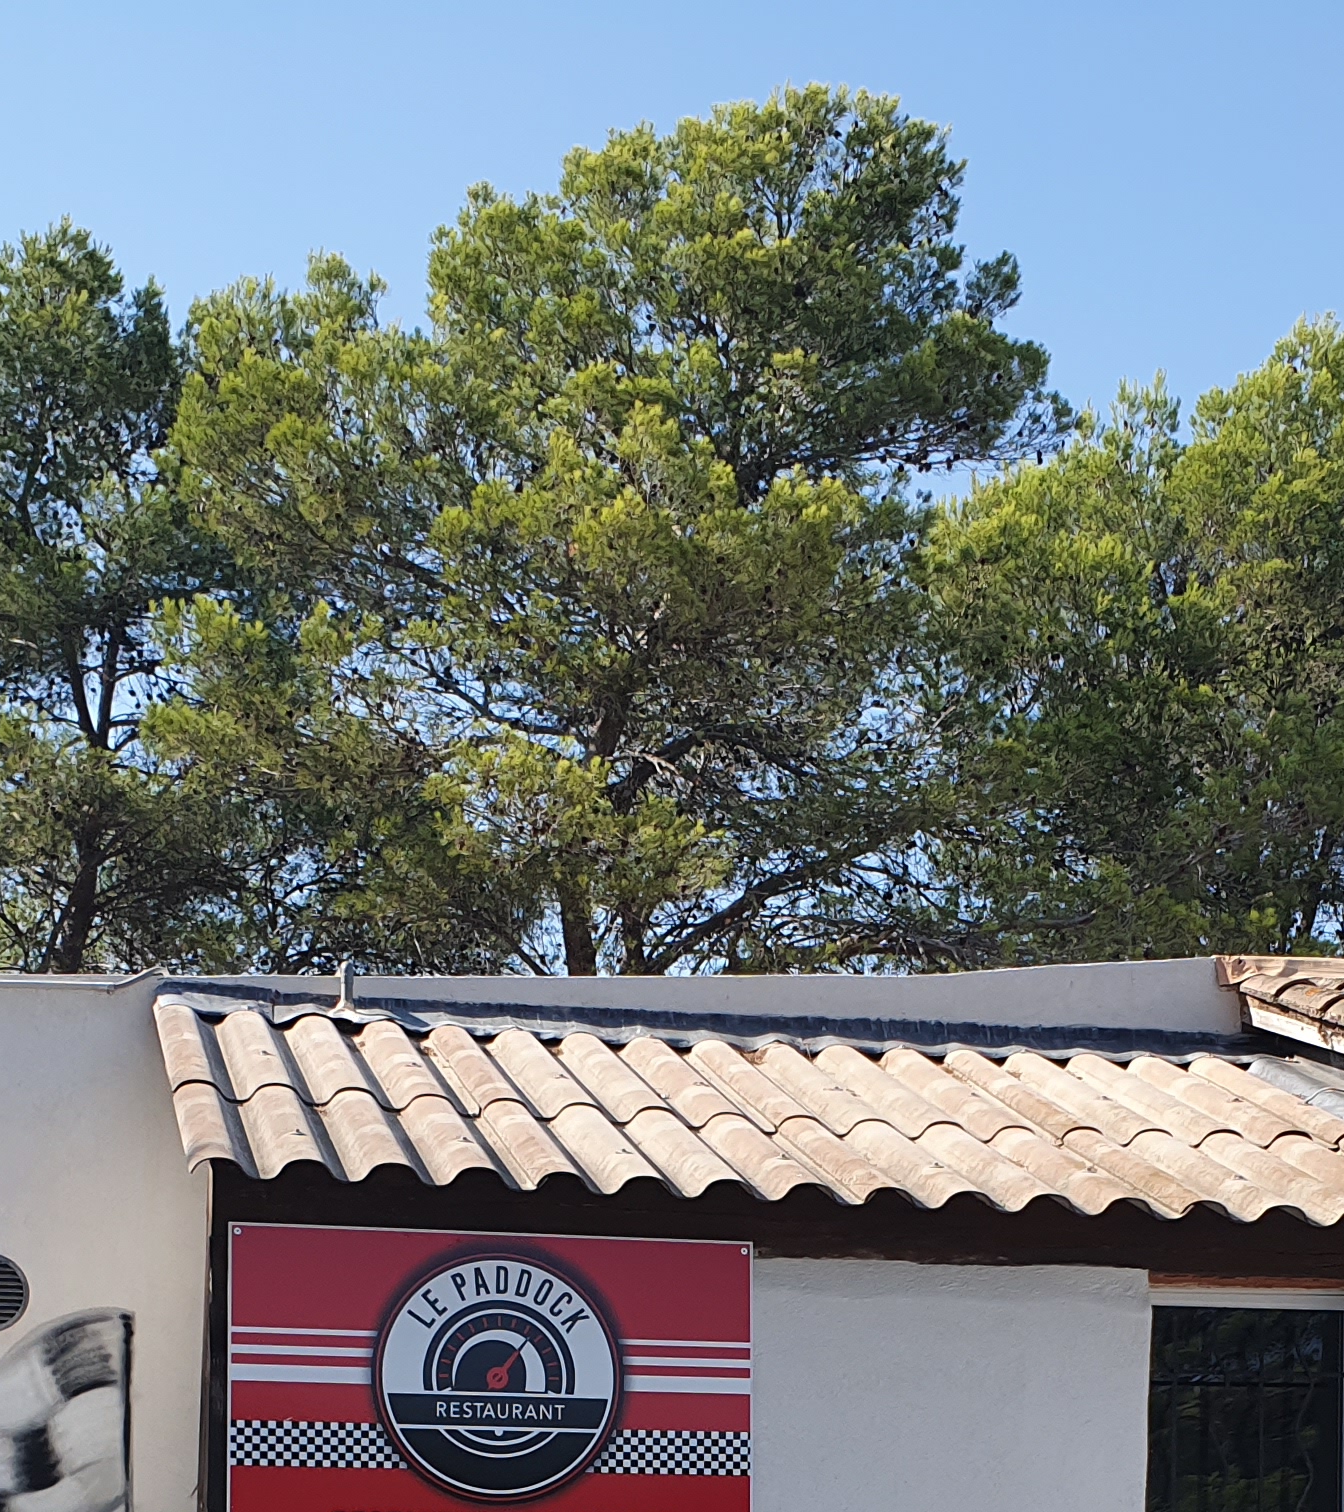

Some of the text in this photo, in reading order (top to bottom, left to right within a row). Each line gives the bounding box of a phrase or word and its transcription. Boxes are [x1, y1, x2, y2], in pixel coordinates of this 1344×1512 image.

[406, 1265, 591, 1336] LE PADDOCK
[435, 1400, 567, 1421] RESTAURANT
